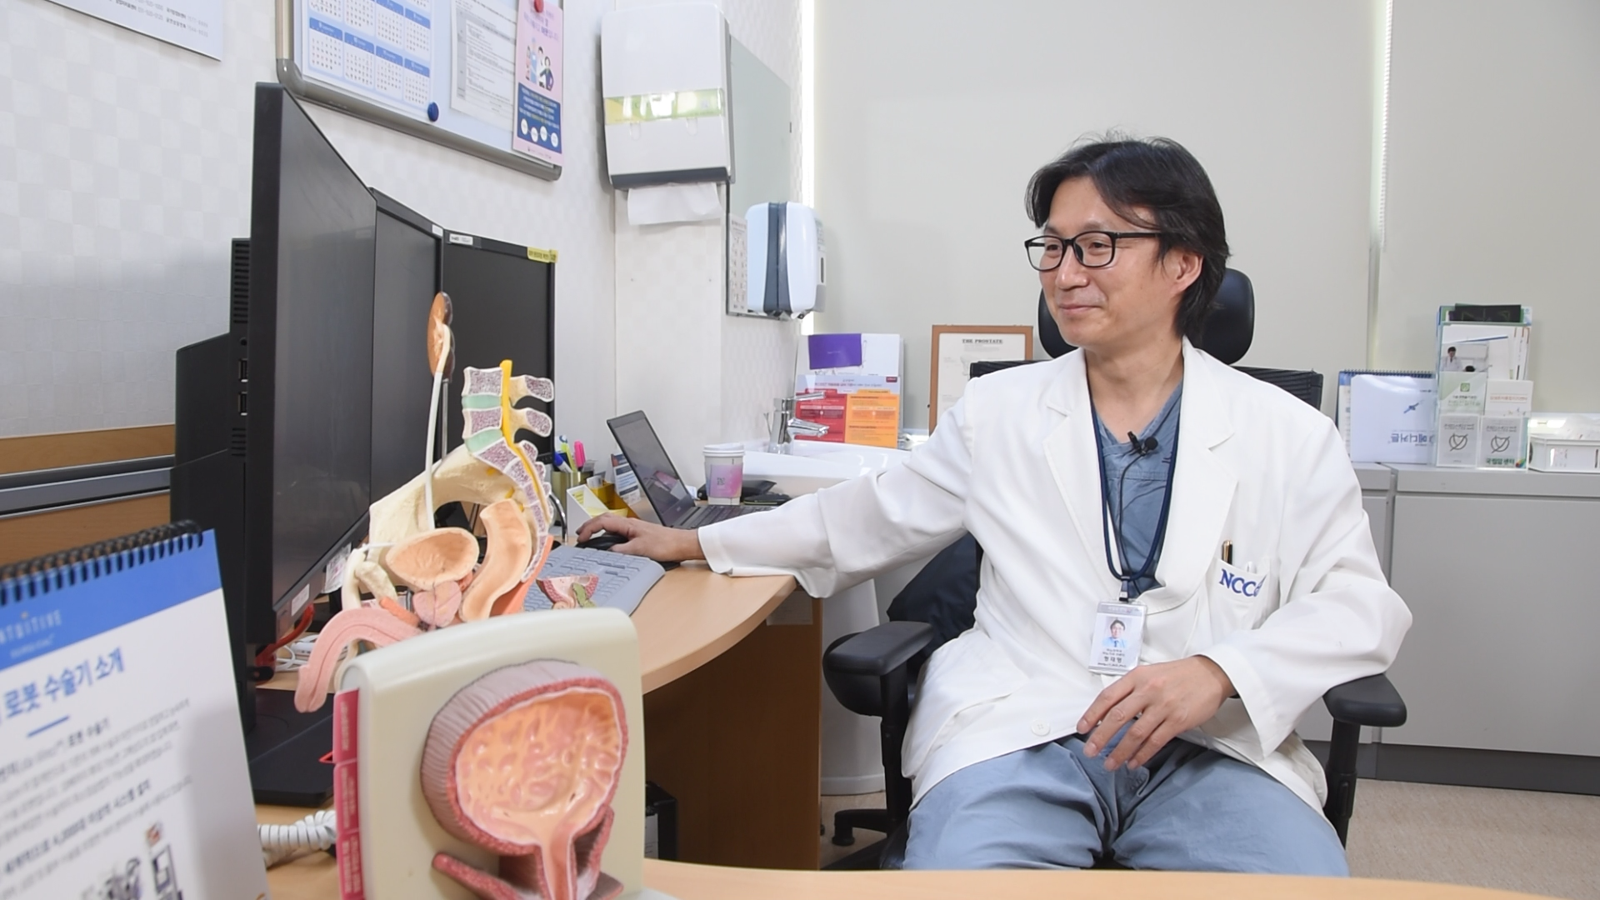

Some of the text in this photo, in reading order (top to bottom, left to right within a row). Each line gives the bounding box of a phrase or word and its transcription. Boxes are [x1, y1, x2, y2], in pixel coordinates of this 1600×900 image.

[4, 648, 125, 718] 로봇 수술기 소개
